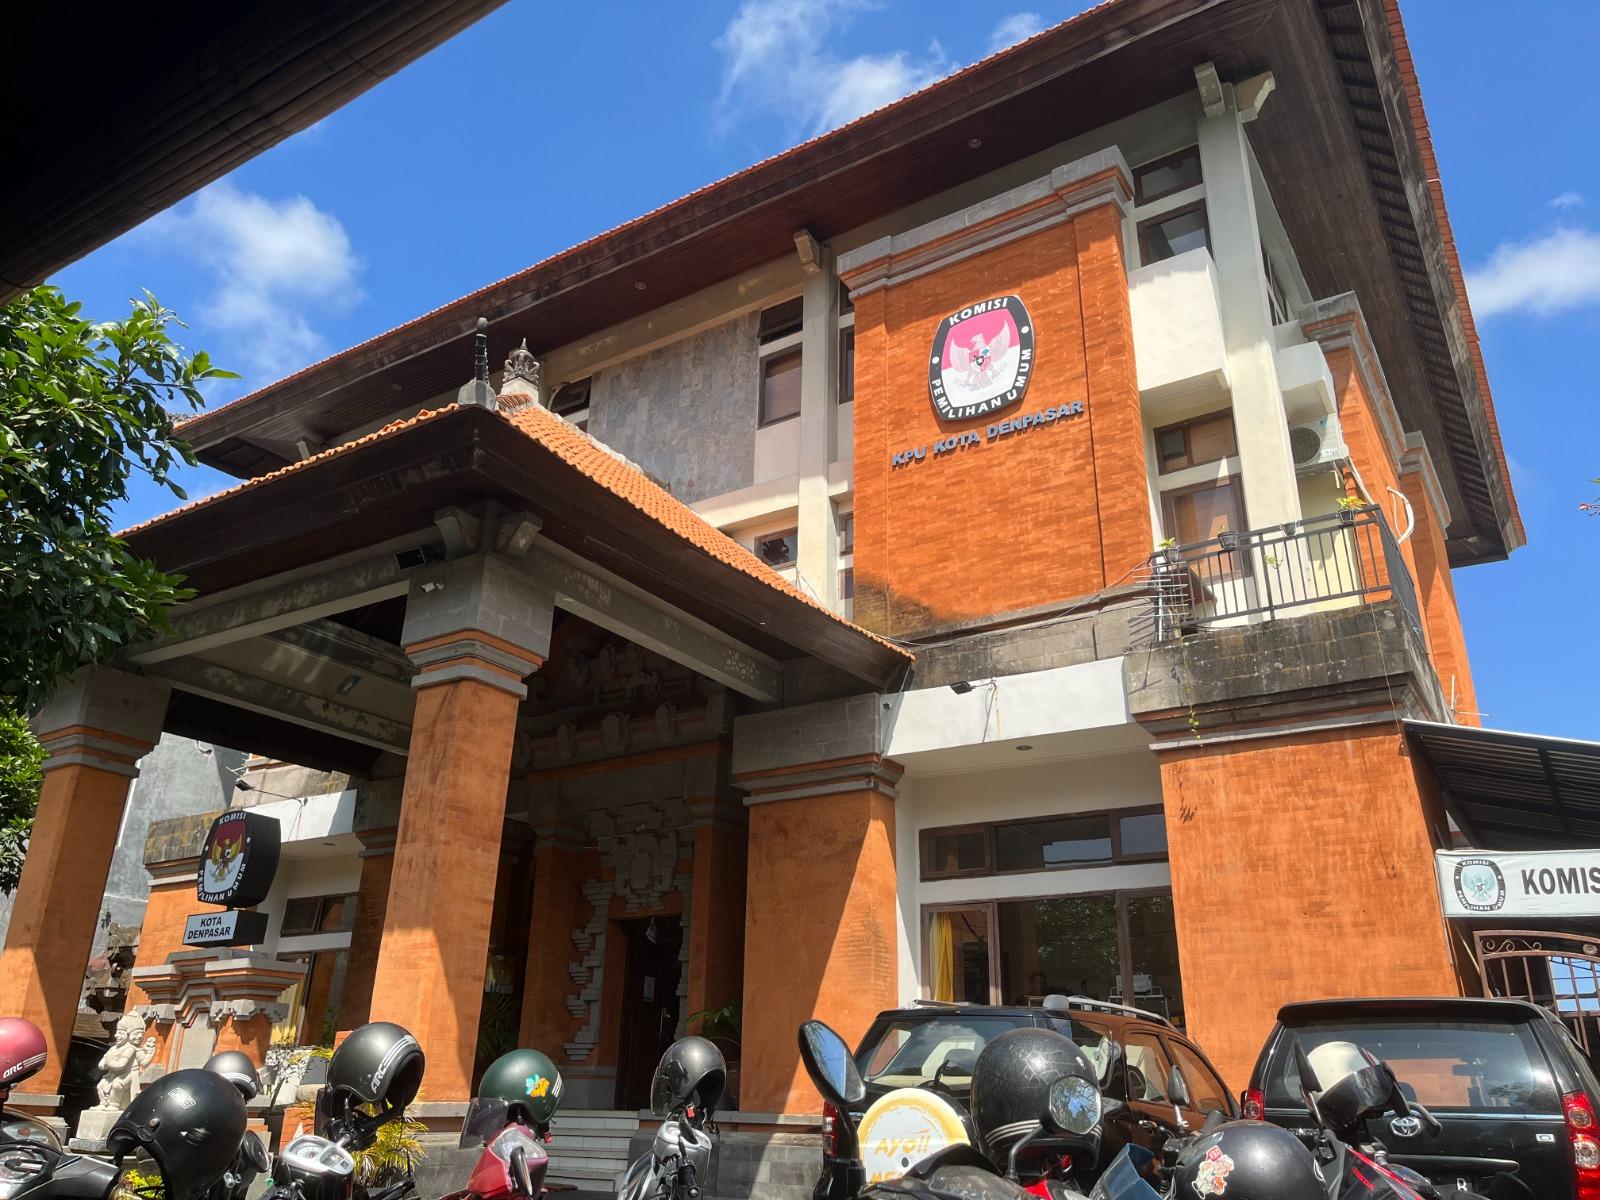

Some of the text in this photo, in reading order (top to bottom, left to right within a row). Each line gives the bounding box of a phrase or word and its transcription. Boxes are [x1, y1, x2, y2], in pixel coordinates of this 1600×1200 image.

[949, 297, 1008, 326] KOMISI
[931, 348, 1032, 419] PEMILIHAN UMUM
[891, 400, 1085, 466] KPU KOTA DENPASAR
[218, 811, 247, 825] KOMISI
[227, 863, 247, 897] UMUM
[187, 926, 231, 940] DENPASAR
[200, 916, 222, 928] KOTA
[2, 1062, 23, 1079] ARC
